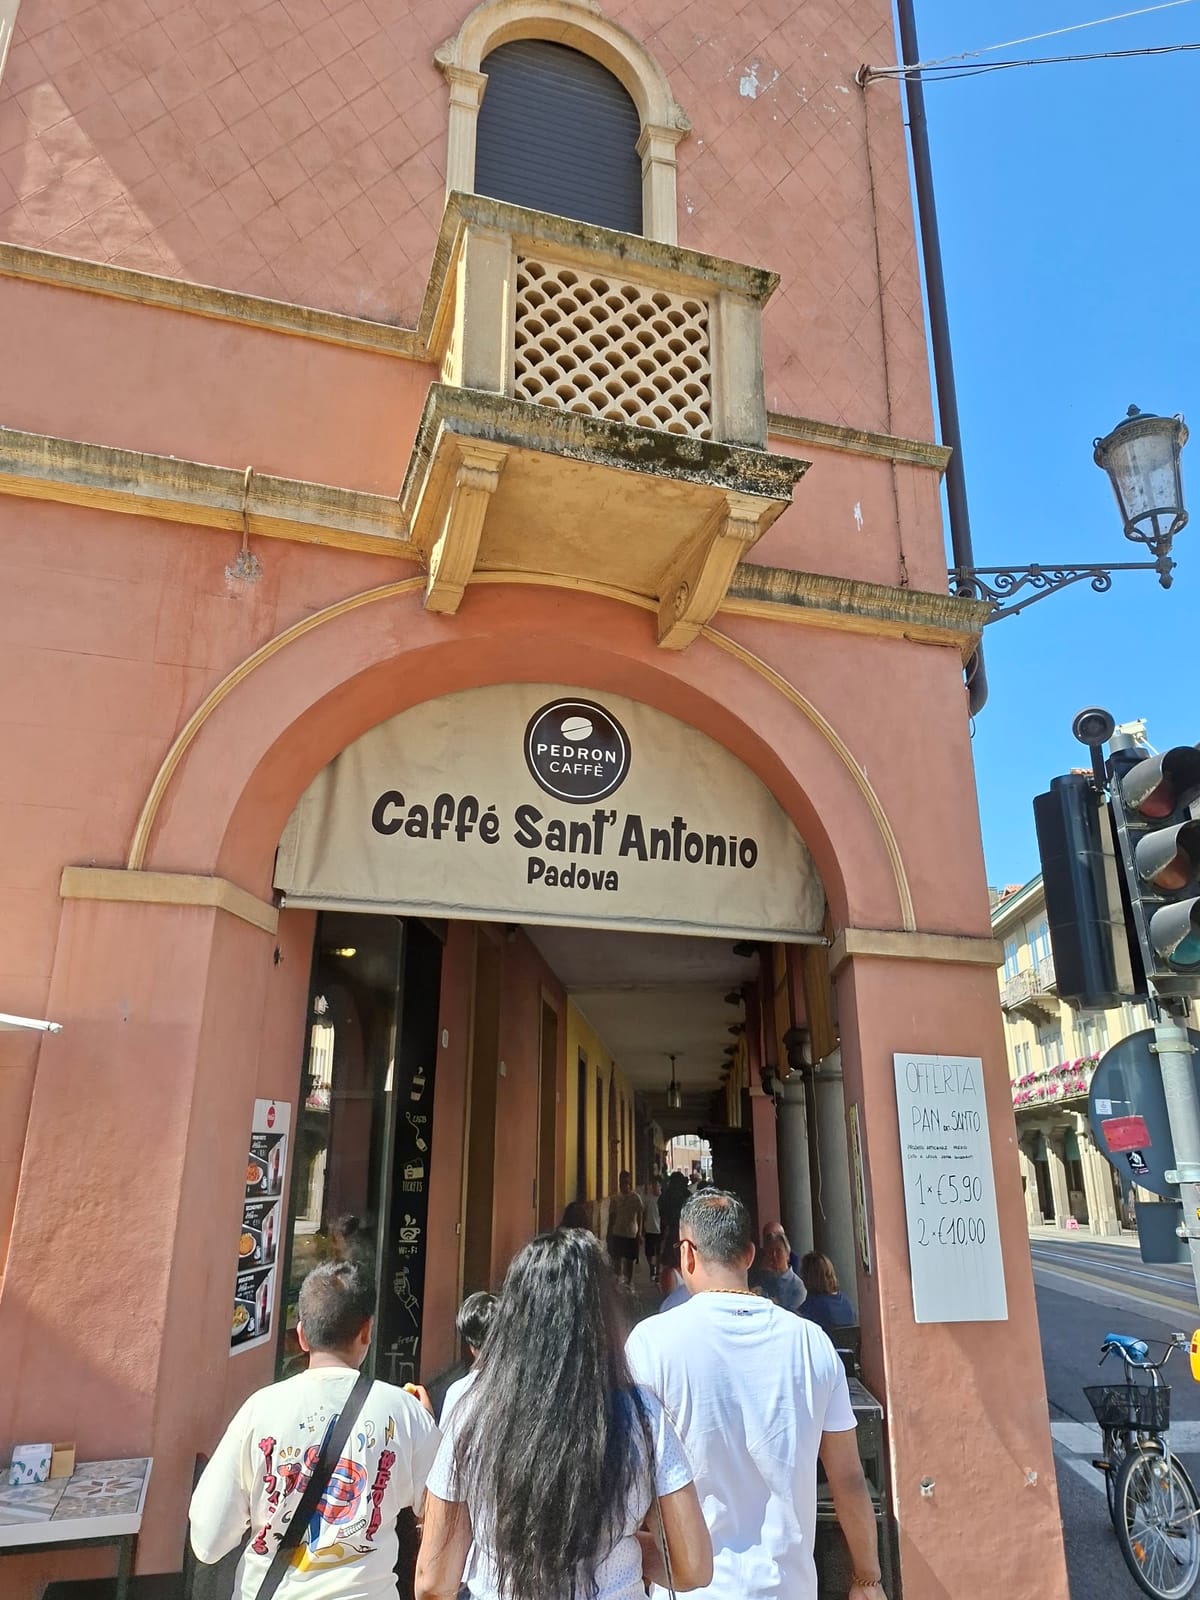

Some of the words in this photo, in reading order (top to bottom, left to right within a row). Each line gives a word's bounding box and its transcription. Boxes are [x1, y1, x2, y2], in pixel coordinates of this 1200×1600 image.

[537, 743, 616, 764] PEDRON
[549, 761, 604, 777] CAFFÈ
[371, 790, 500, 845] Caffé
[527, 856, 619, 891] Padova
[906, 1062, 977, 1095] OFFERTA
[911, 1105, 941, 1133] PAN
[951, 1110, 981, 1132] SANTO
[402, 1180, 423, 1192] TICKETS
